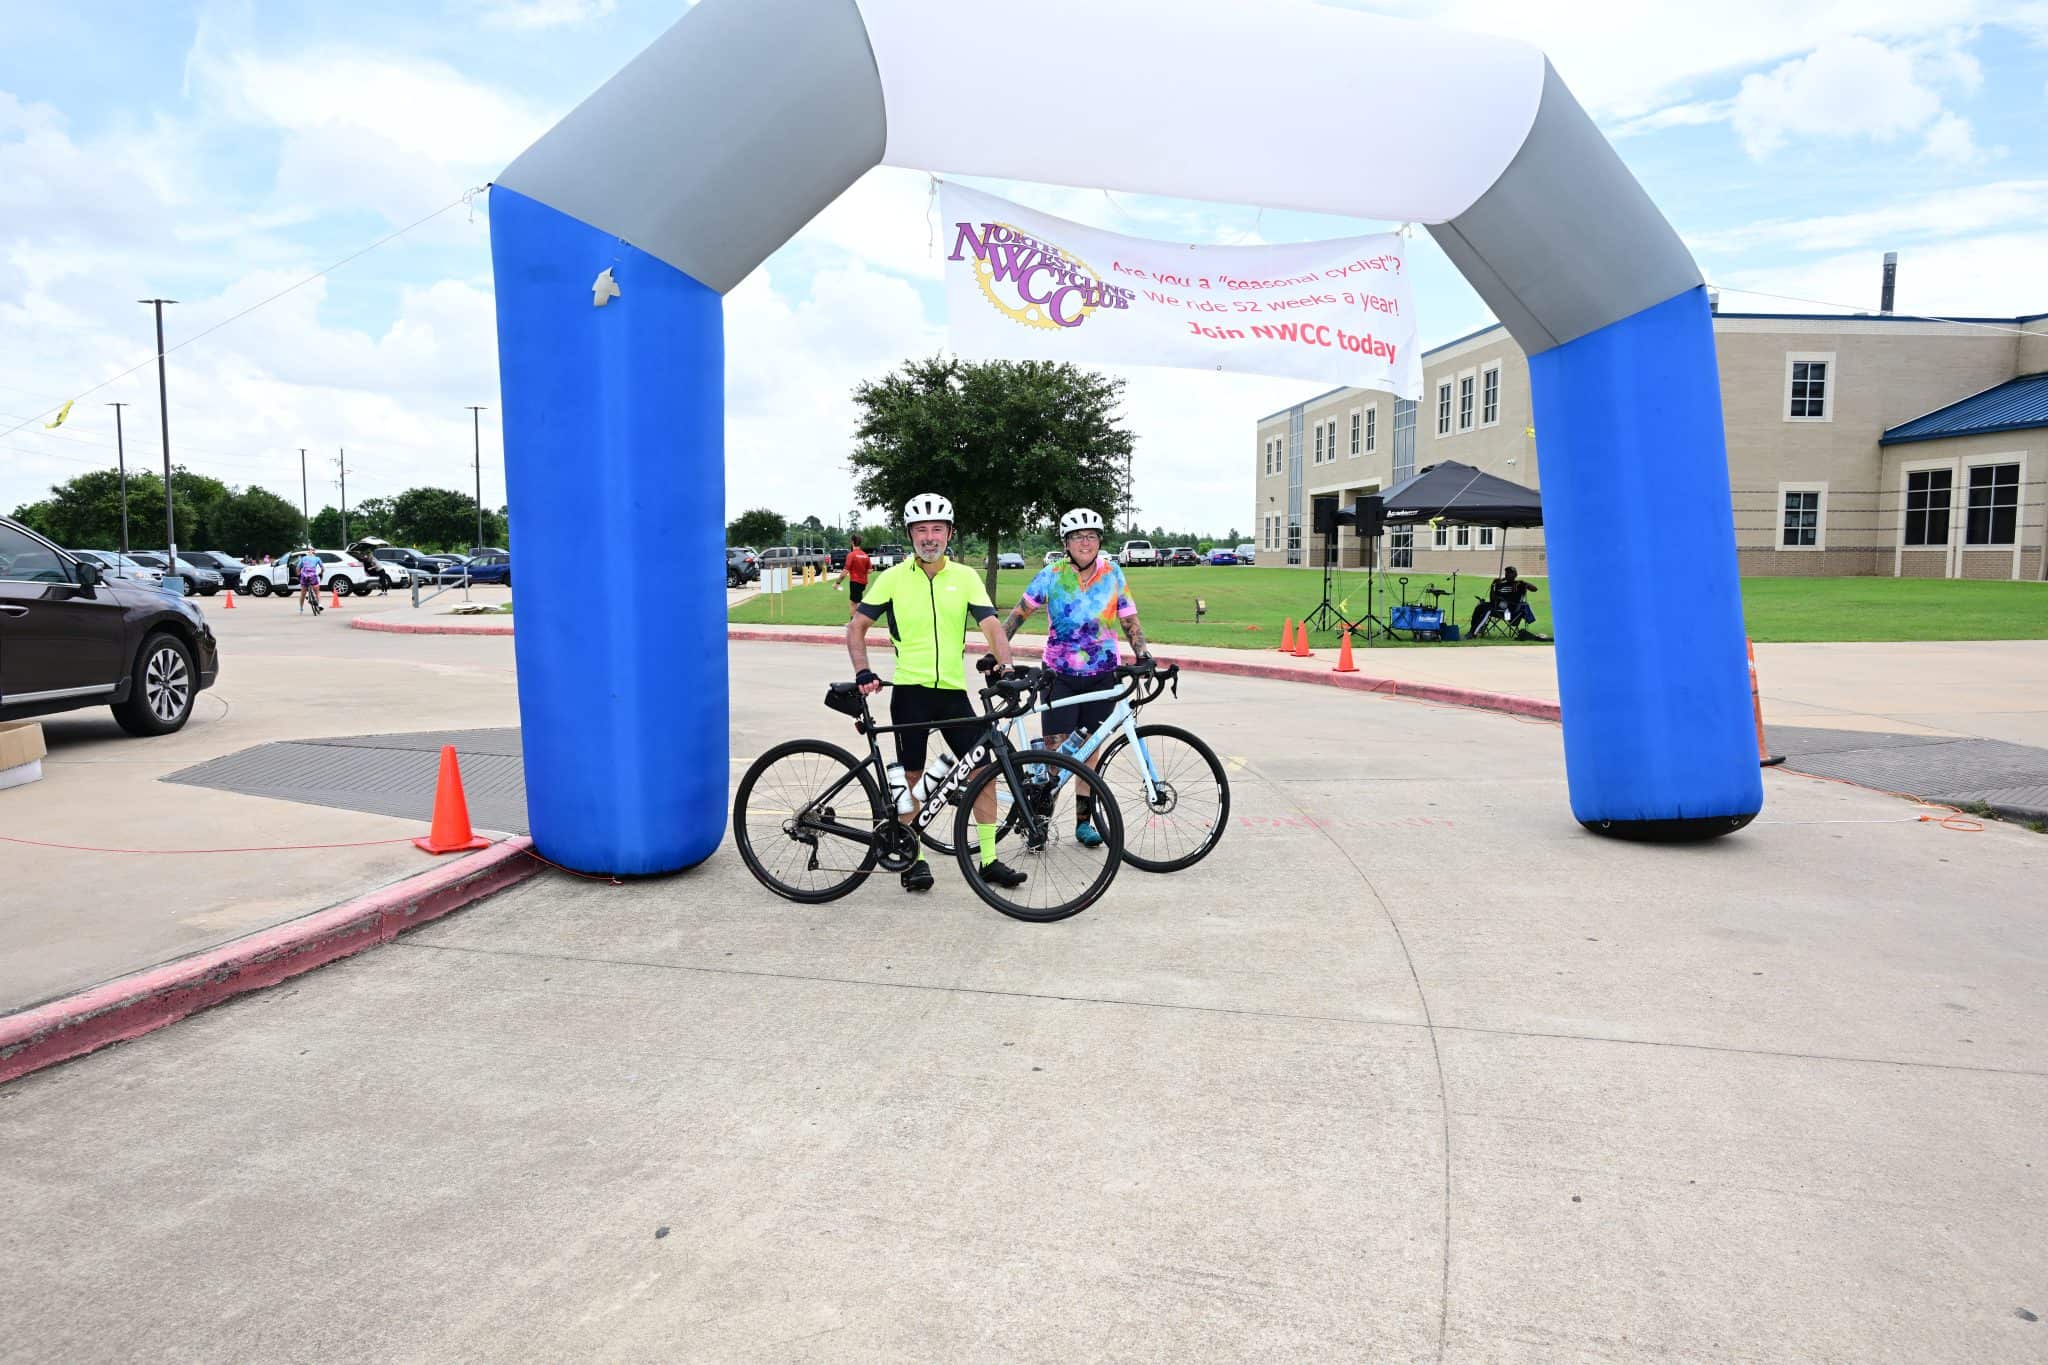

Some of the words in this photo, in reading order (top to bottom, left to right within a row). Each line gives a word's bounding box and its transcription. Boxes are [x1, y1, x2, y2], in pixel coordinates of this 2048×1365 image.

[1113, 261, 1147, 279] Are
[1152, 272, 1191, 288] you
[1198, 278, 1211, 289] a
[1218, 272, 1320, 291] "seasonal
[1324, 254, 1402, 277] cyclist"?
[1142, 289, 1180, 306] We
[1186, 299, 1229, 312] ride
[1232, 300, 1263, 312] 52
[1266, 293, 1337, 312] weeks
[1341, 292, 1355, 305] a
[1359, 292, 1400, 317] year!
[1186, 321, 1246, 340] Join
[1249, 322, 1333, 348] NWCC
[1336, 328, 1397, 365] today
